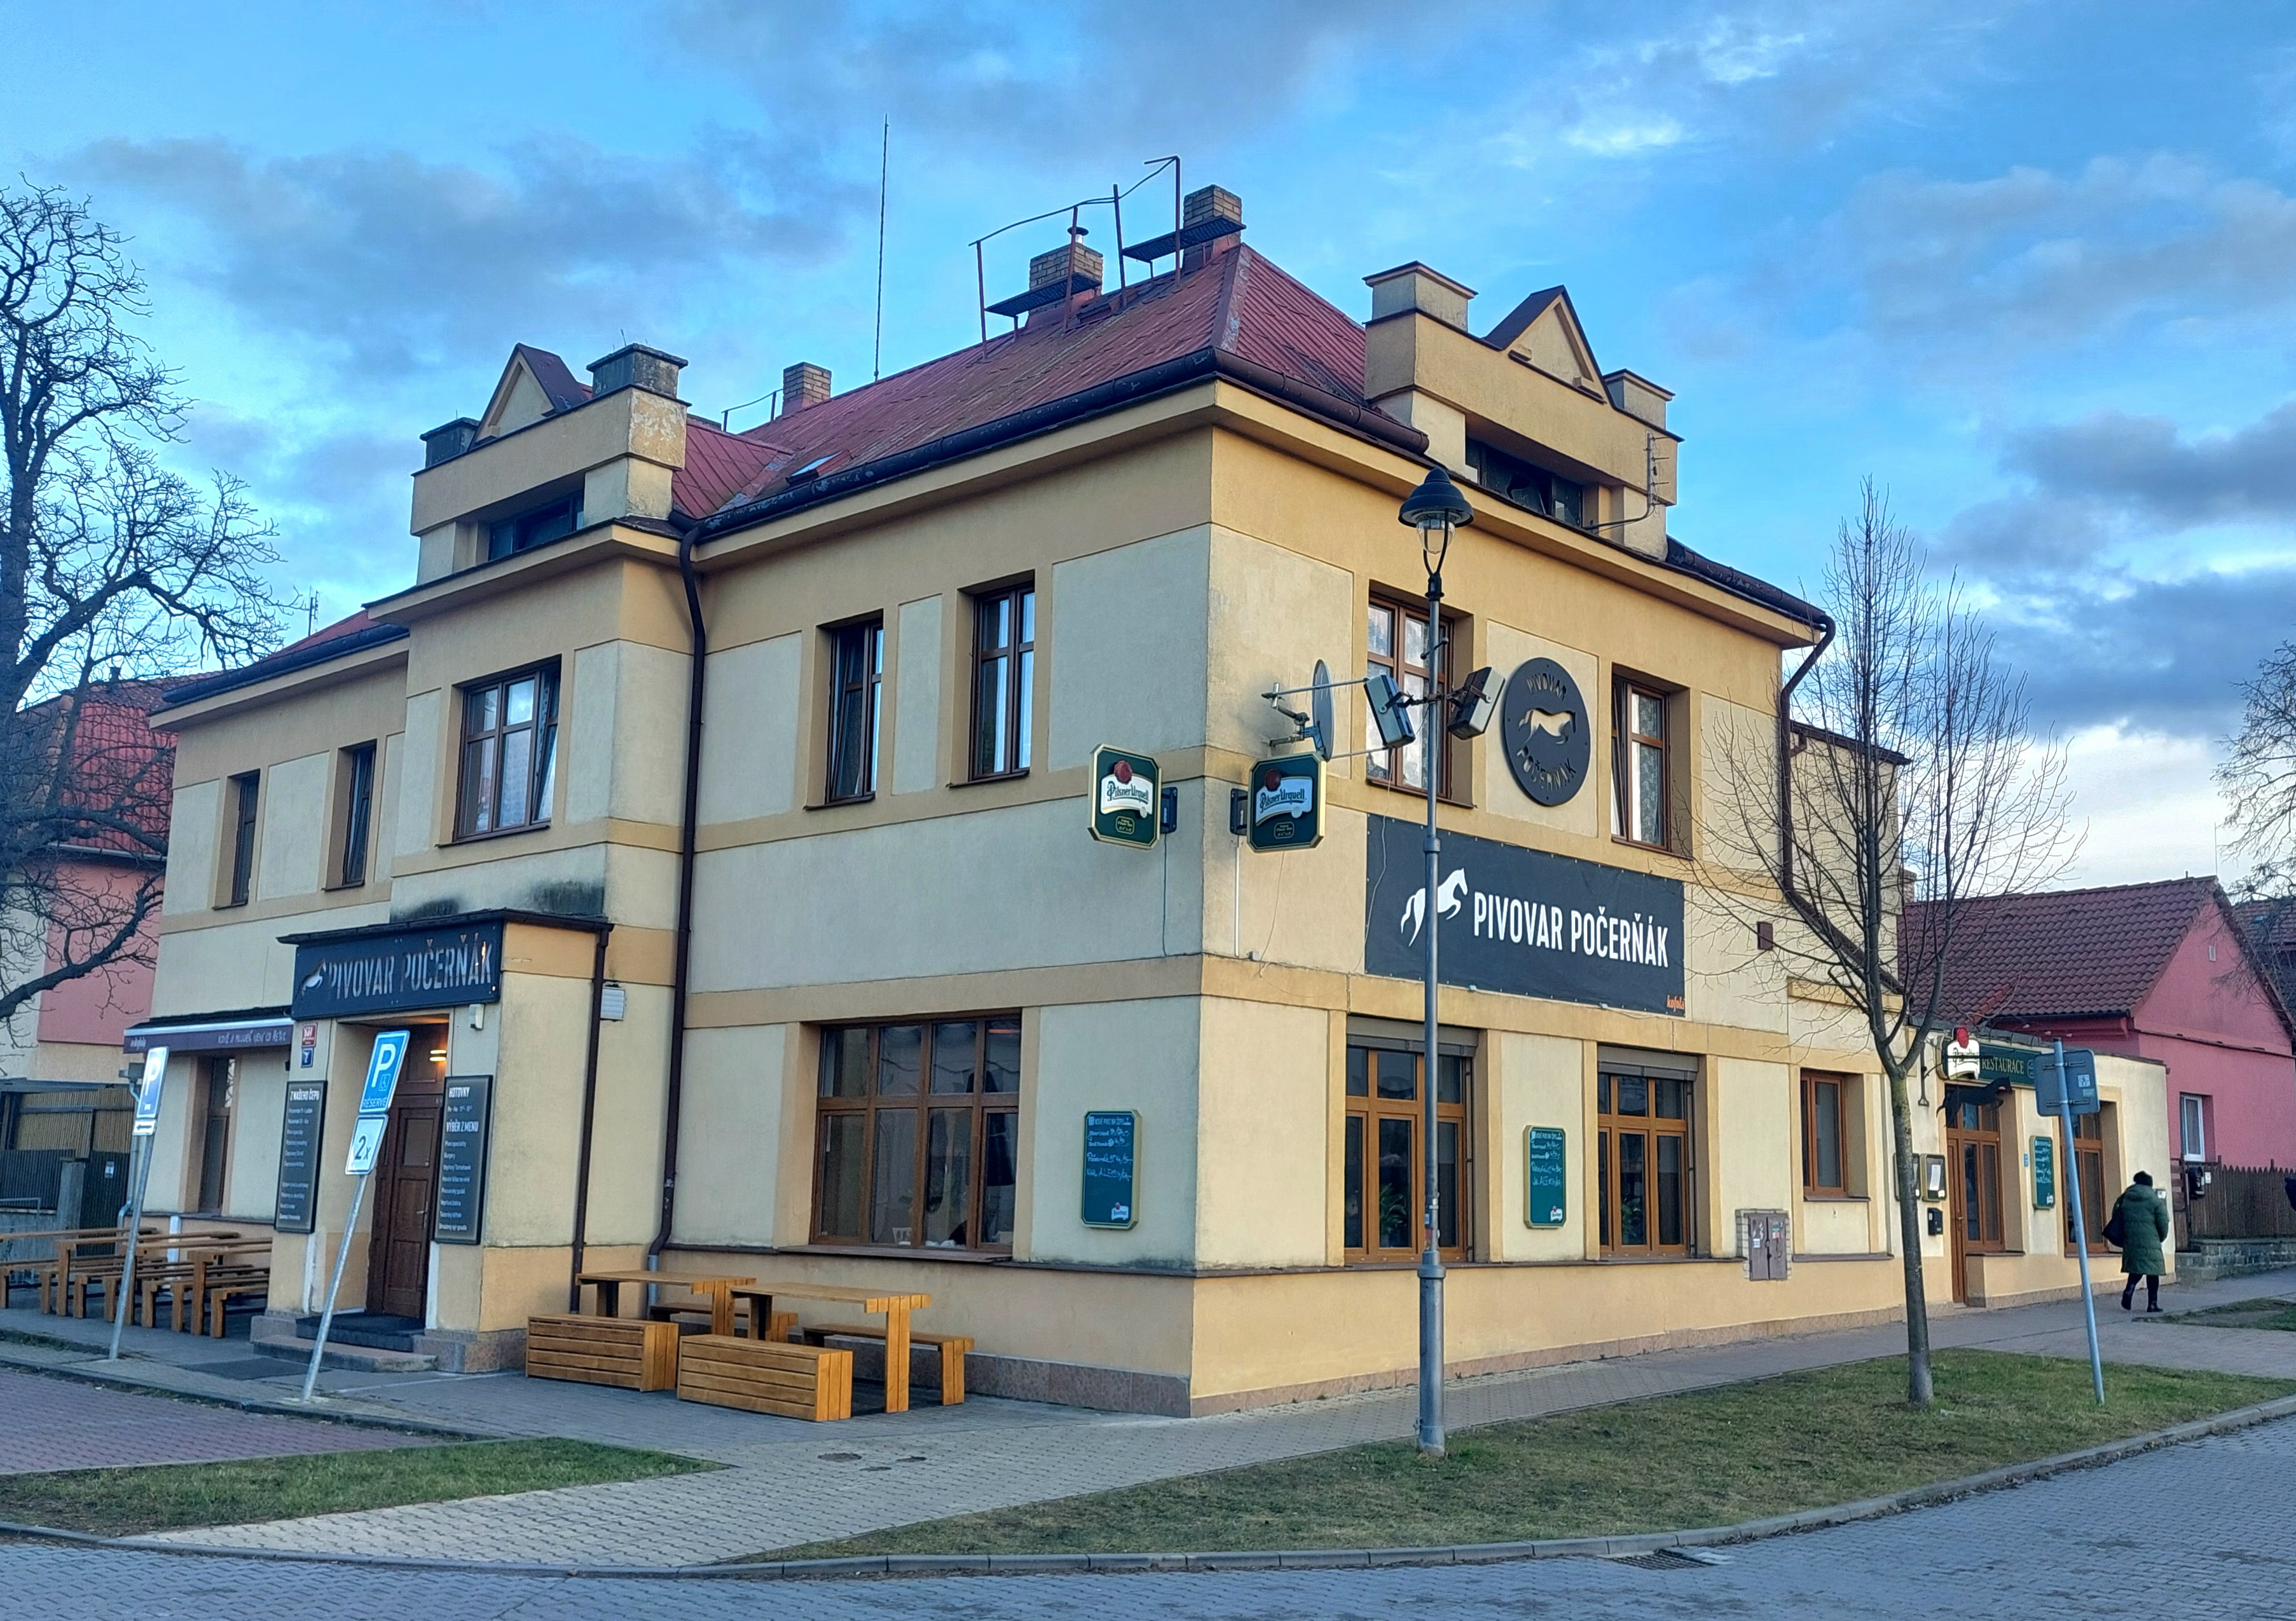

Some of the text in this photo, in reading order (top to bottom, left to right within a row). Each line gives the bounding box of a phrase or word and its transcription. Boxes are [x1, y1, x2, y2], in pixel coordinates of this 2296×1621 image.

[1526, 673, 1567, 701] PIVOVAR
[1107, 781, 1149, 804] Pilsner Urquell
[1260, 788, 1305, 814] Pilsner Urquell
[1474, 891, 1669, 968] PIVOVAR POČERŇÁK
[328, 932, 493, 1000] PIVOVAR POČERŇÁK
[1667, 994, 1684, 1012] kofola
[144, 1057, 161, 1096] P
[371, 1043, 396, 1088] P
[1982, 1057, 2024, 1075] RESTAURACE
[362, 1097, 388, 1108] RÉSERVÉ
[448, 1086, 471, 1098] HOTOVKY
[446, 1119, 460, 1132] VÝBĚR
[464, 1121, 479, 1132] MENU
[355, 1135, 371, 1160] 2x
